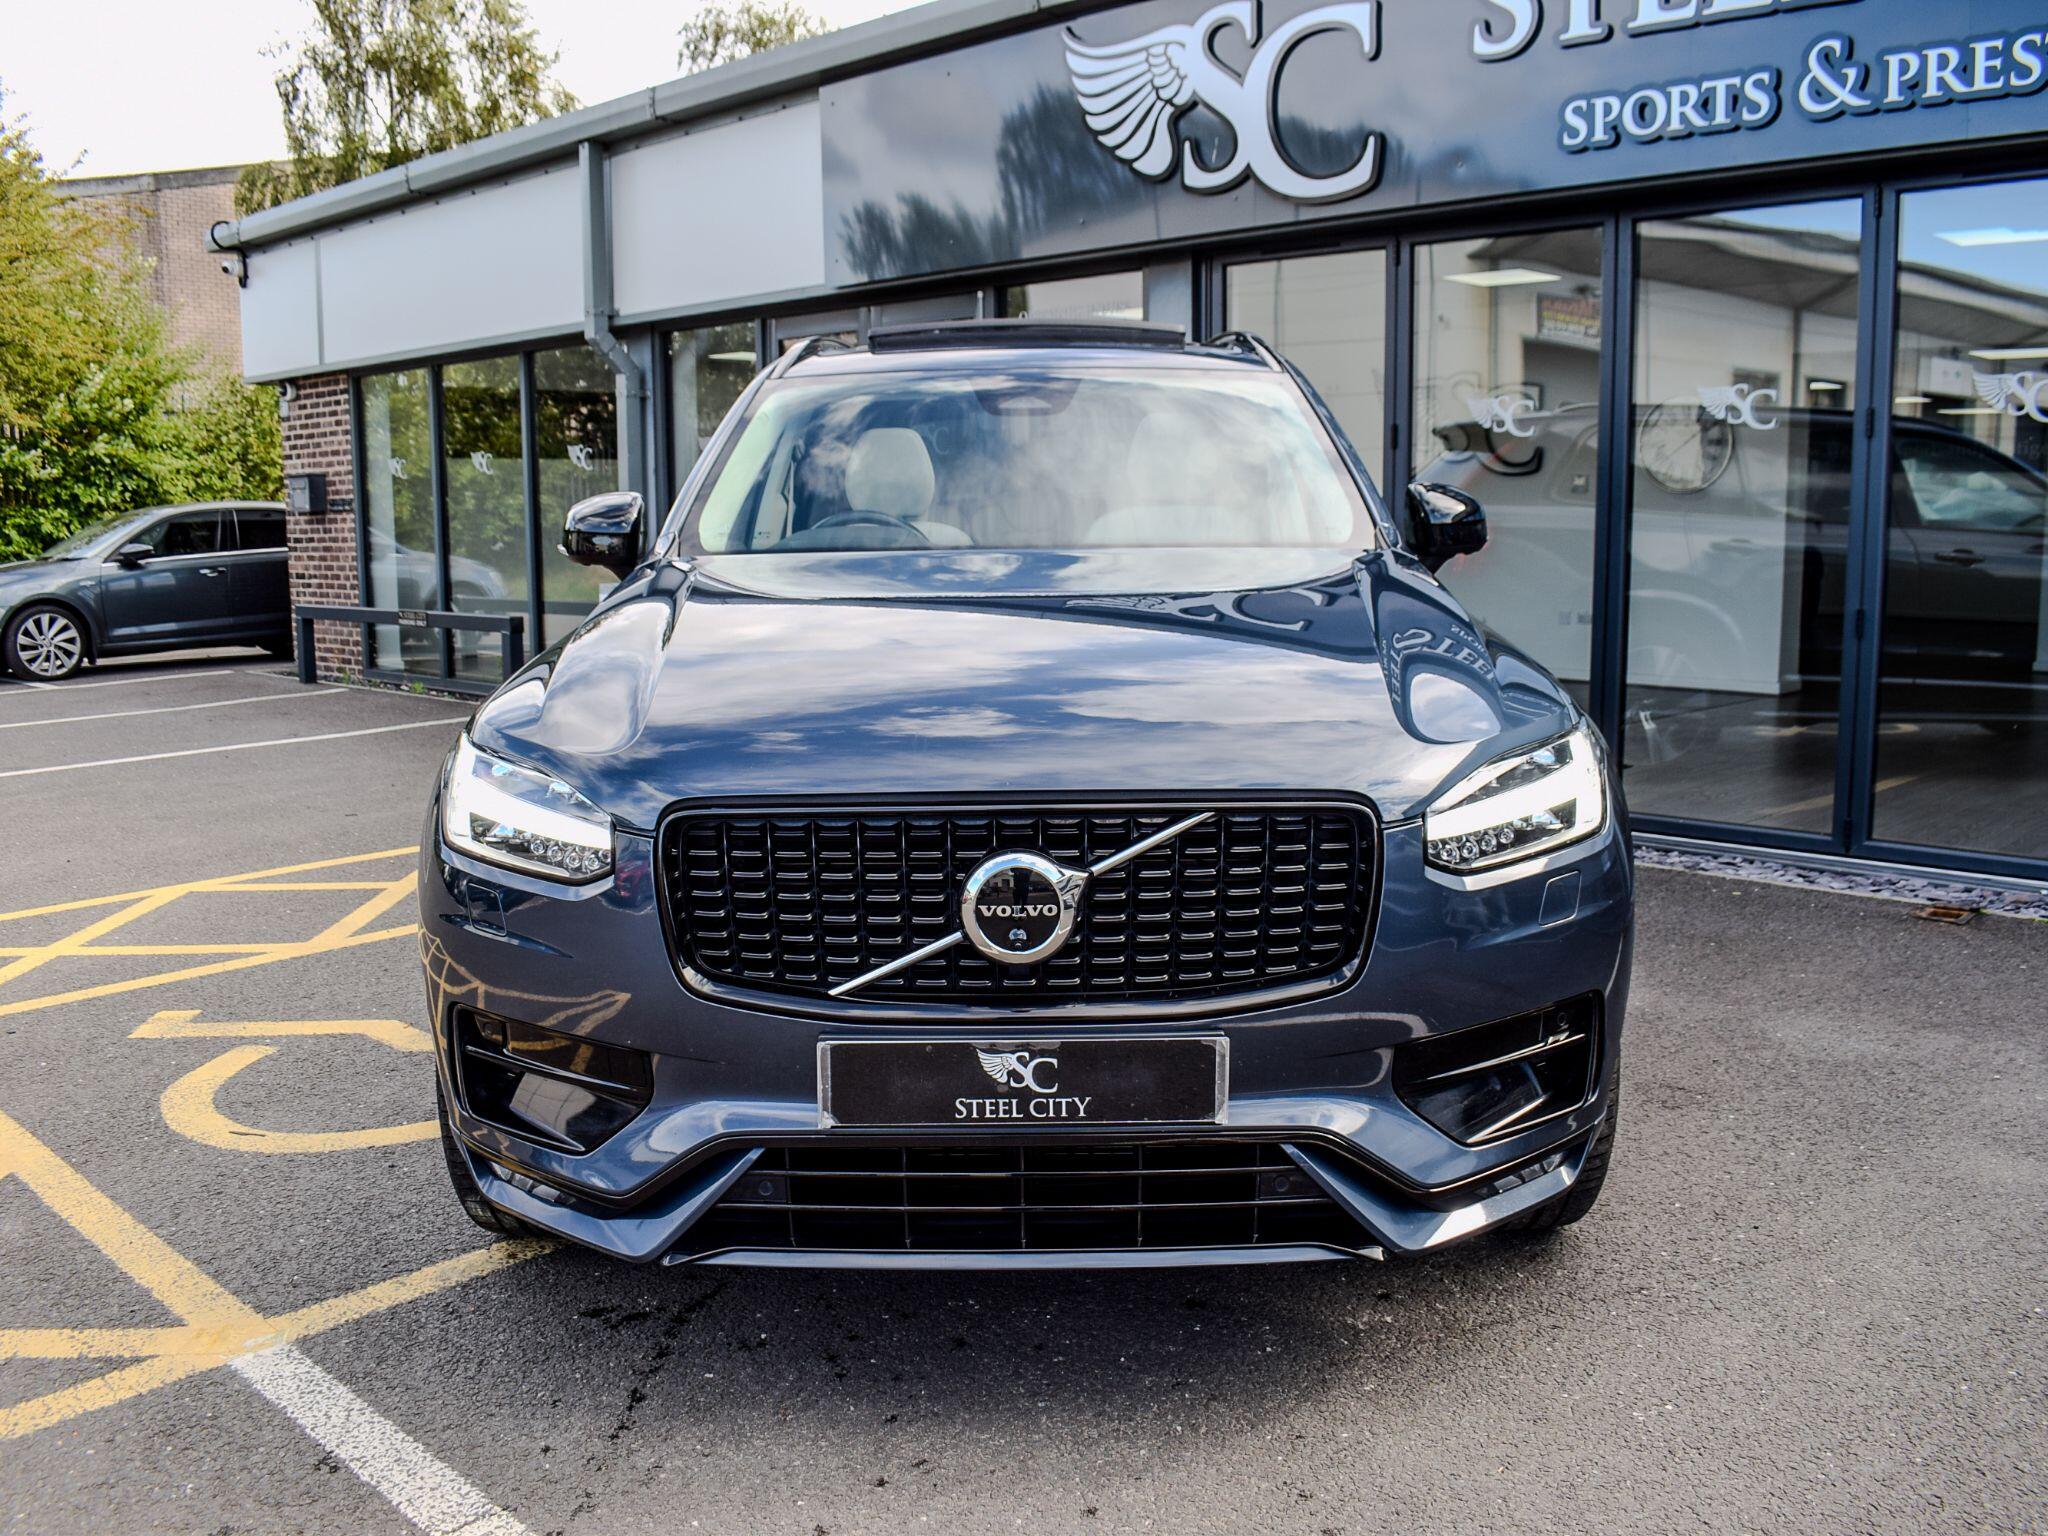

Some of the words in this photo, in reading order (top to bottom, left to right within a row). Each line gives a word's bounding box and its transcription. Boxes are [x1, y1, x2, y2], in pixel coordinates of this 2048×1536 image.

[1183, 0, 1375, 199] SC
[1562, 72, 1771, 147] SPORTS
[1798, 38, 1871, 113] &
[1883, 32, 2048, 104] PRES
[1490, 395, 1535, 437] SC
[1726, 383, 1777, 430] SC
[978, 904, 1059, 917] VOLVO
[1009, 1051, 1059, 1094] SC
[954, 1097, 1024, 1119] STEEL
[1029, 1096, 1092, 1118] CITY
